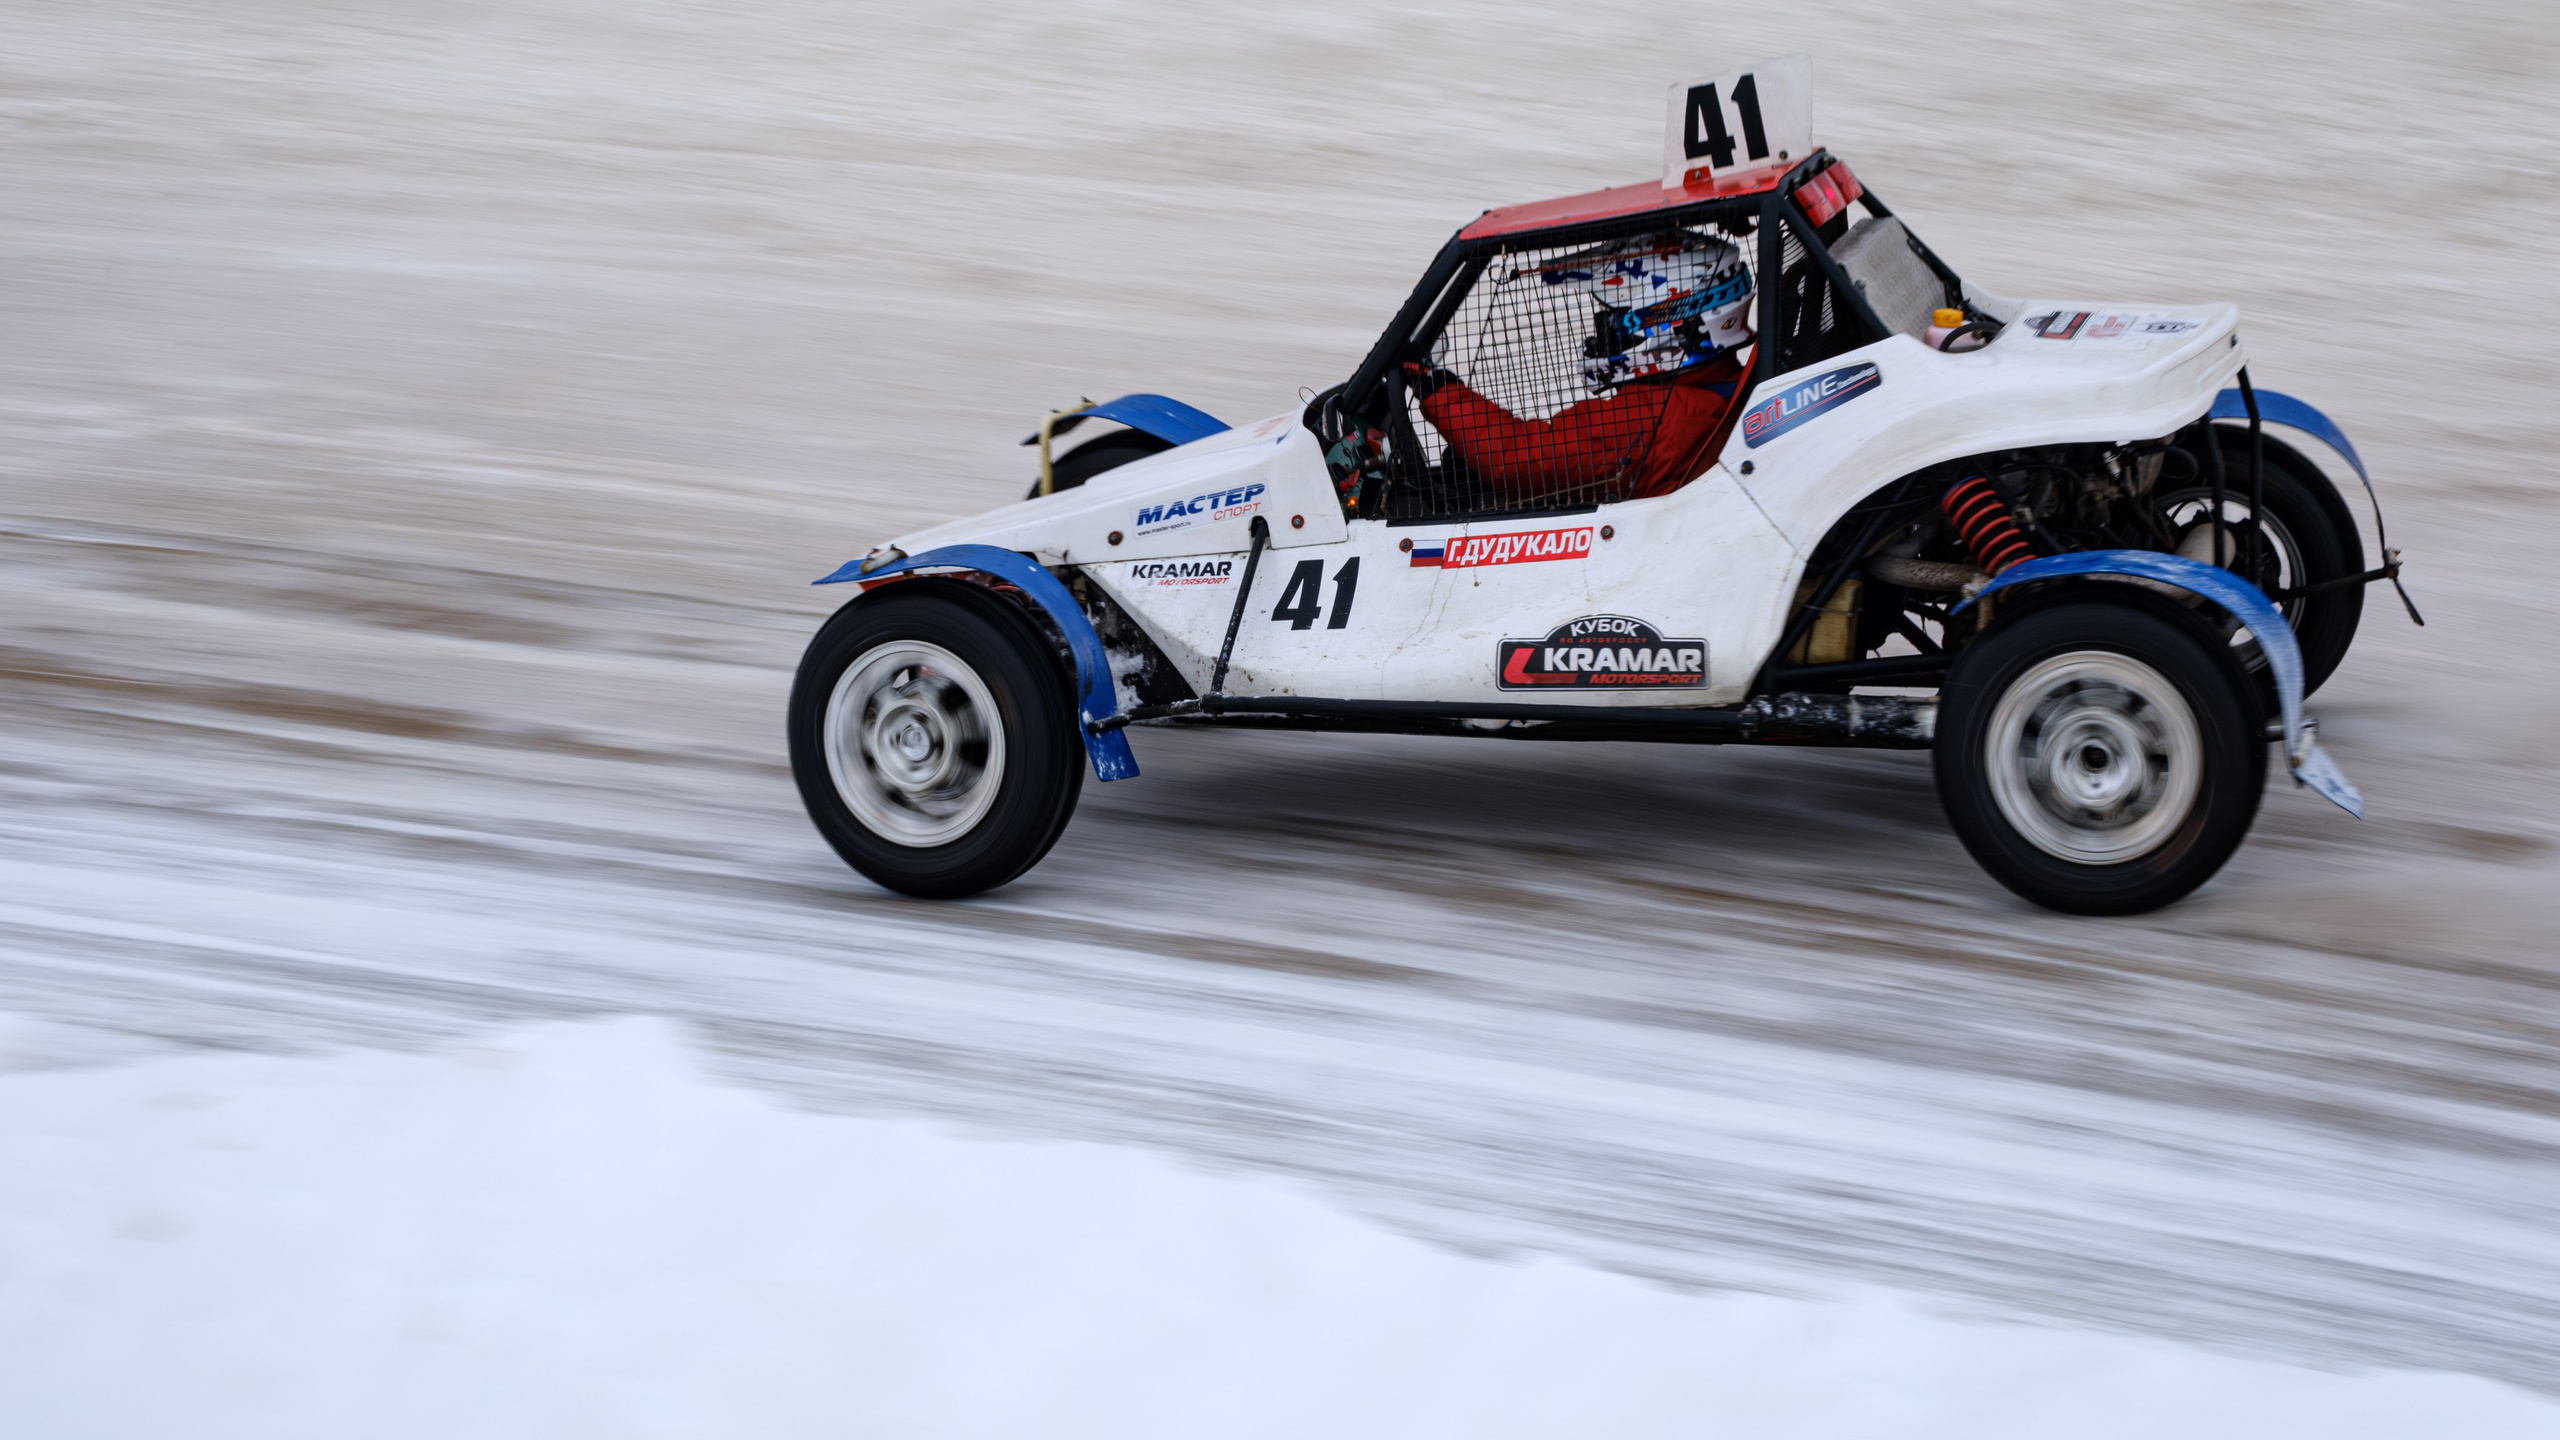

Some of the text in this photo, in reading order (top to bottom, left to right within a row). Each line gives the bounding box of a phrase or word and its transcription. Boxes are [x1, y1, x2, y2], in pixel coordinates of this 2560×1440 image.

[1684, 72, 1769, 169] 41
[1136, 483, 1266, 526] МАСТЕР
[1213, 502, 1262, 521] СПОРТ
[1447, 528, 1593, 566] Г.ДУДУКАЛО
[1131, 561, 1232, 579] KRAMAR
[1271, 556, 1360, 630] 41
[1570, 618, 1640, 637] КУБОК
[1543, 647, 1702, 673] KRAMAR
[1589, 674, 1703, 684] MOTORSPORT
